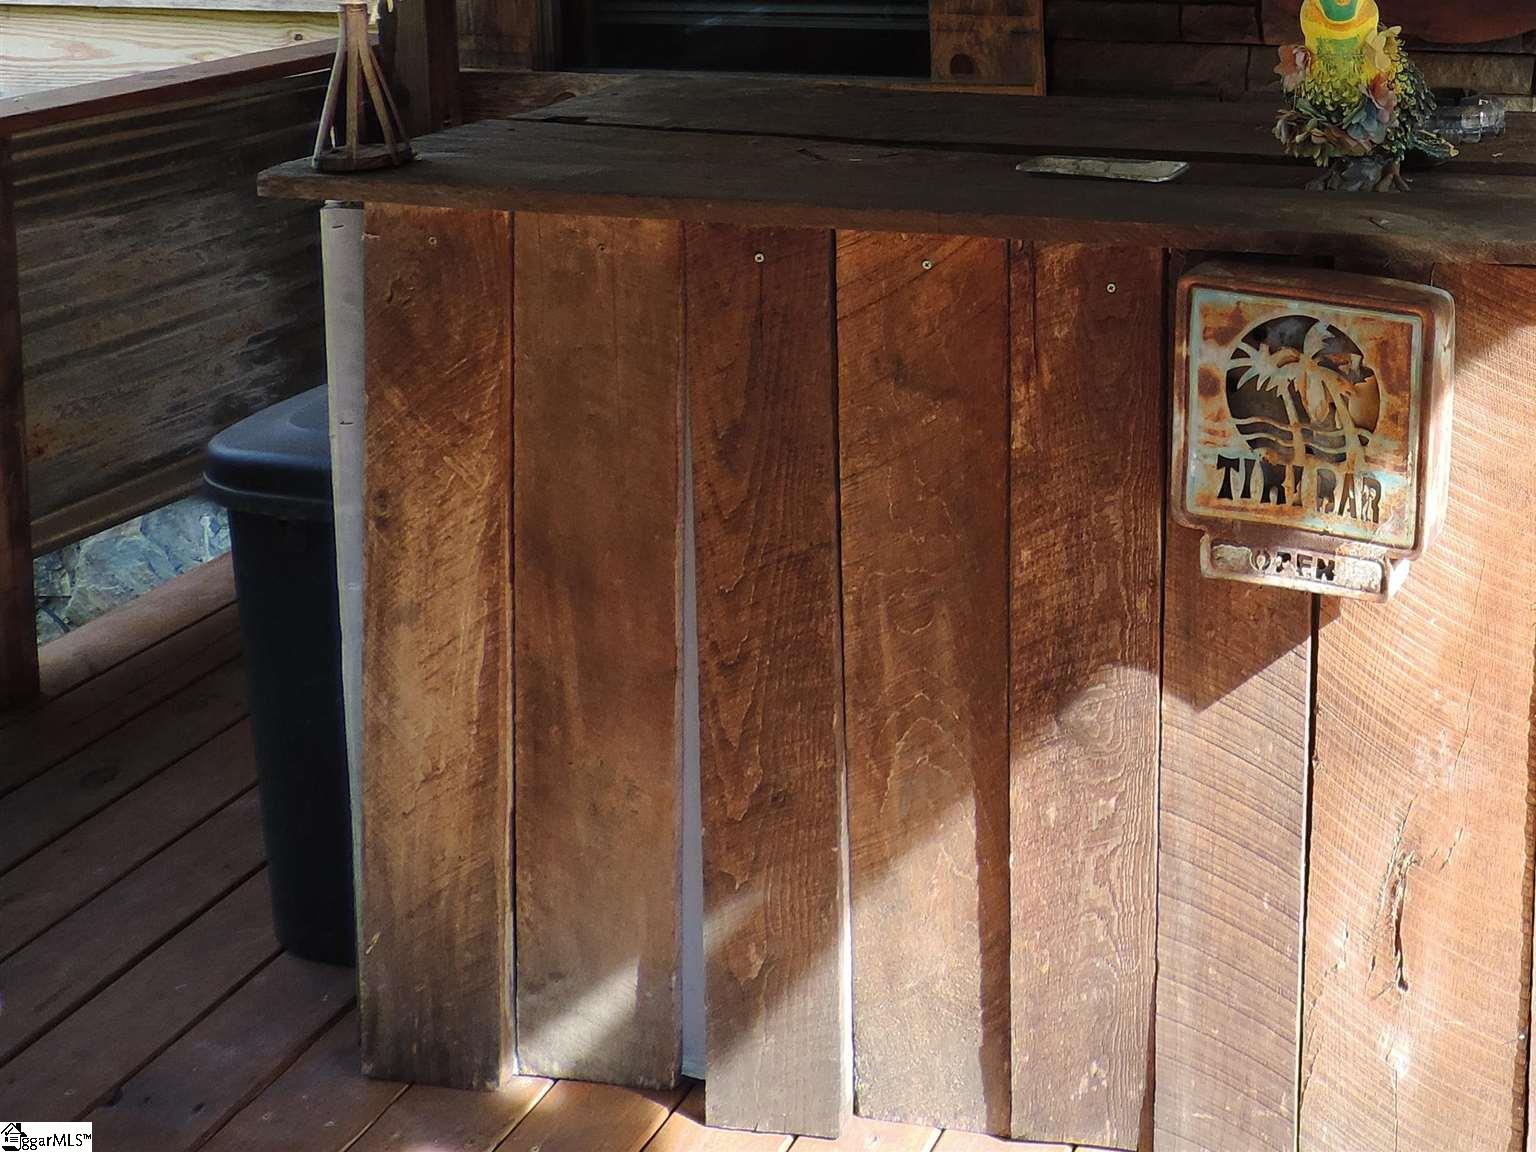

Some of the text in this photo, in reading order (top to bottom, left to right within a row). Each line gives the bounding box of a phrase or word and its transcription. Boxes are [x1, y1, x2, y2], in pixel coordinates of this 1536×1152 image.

[1216, 453, 1383, 524] TIKI BAR
[1250, 549, 1336, 582] OPEN
